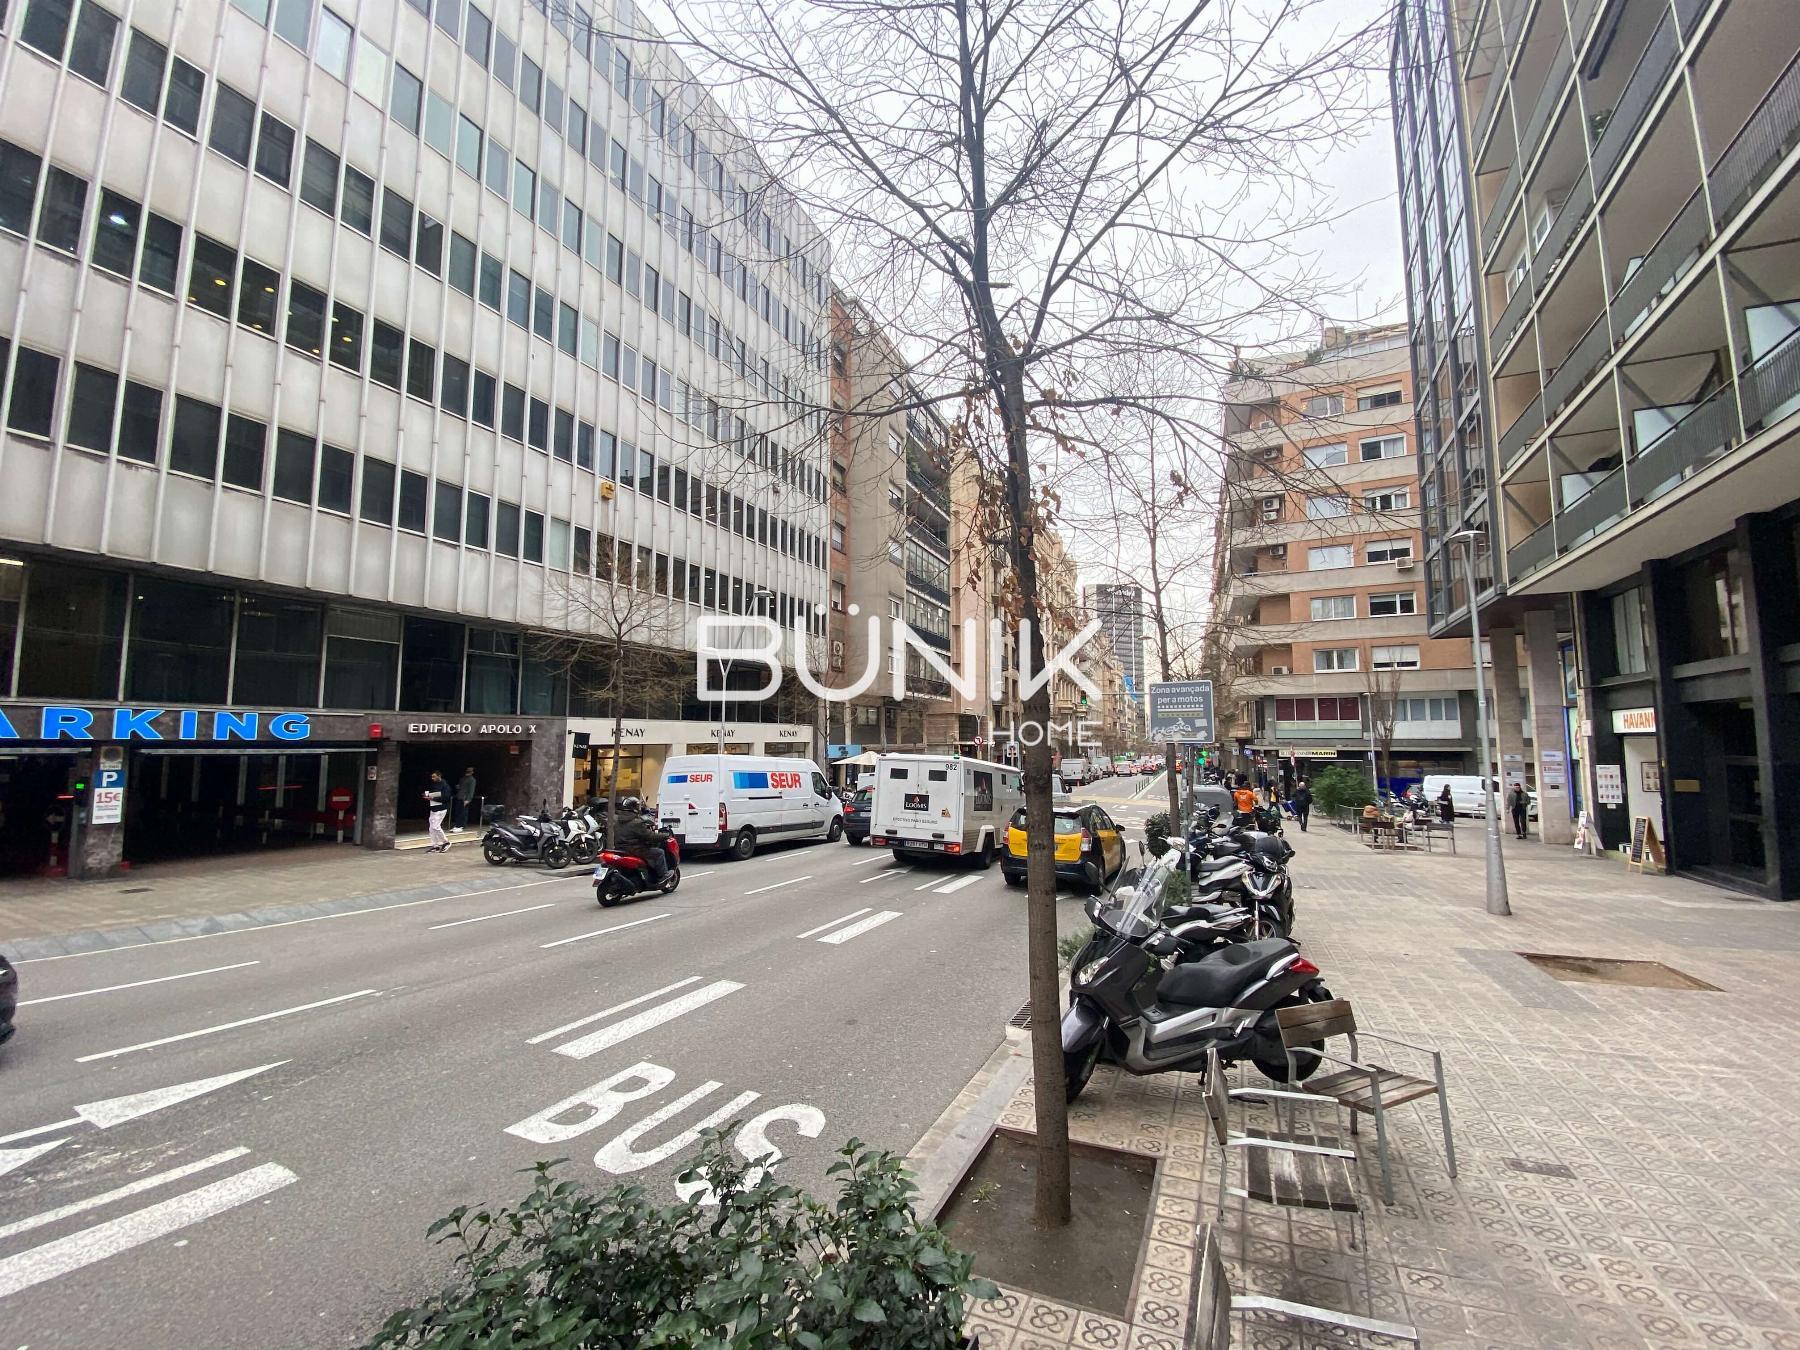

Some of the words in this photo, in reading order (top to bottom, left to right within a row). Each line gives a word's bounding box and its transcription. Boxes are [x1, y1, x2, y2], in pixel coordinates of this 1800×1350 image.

[1151, 686, 1170, 694] Zona
[1171, 684, 1210, 694] avançada
[1157, 696, 1170, 705] per
[1177, 695, 1204, 703] motos
[408, 723, 472, 734] EDIFICIO
[480, 724, 522, 734] APOLO
[529, 724, 537, 734] X
[102, 771, 118, 788] P
[689, 773, 713, 783] SEUR
[770, 772, 802, 789] SEUR
[96, 792, 121, 804] 15€
[502, 1061, 826, 1206] BUS
